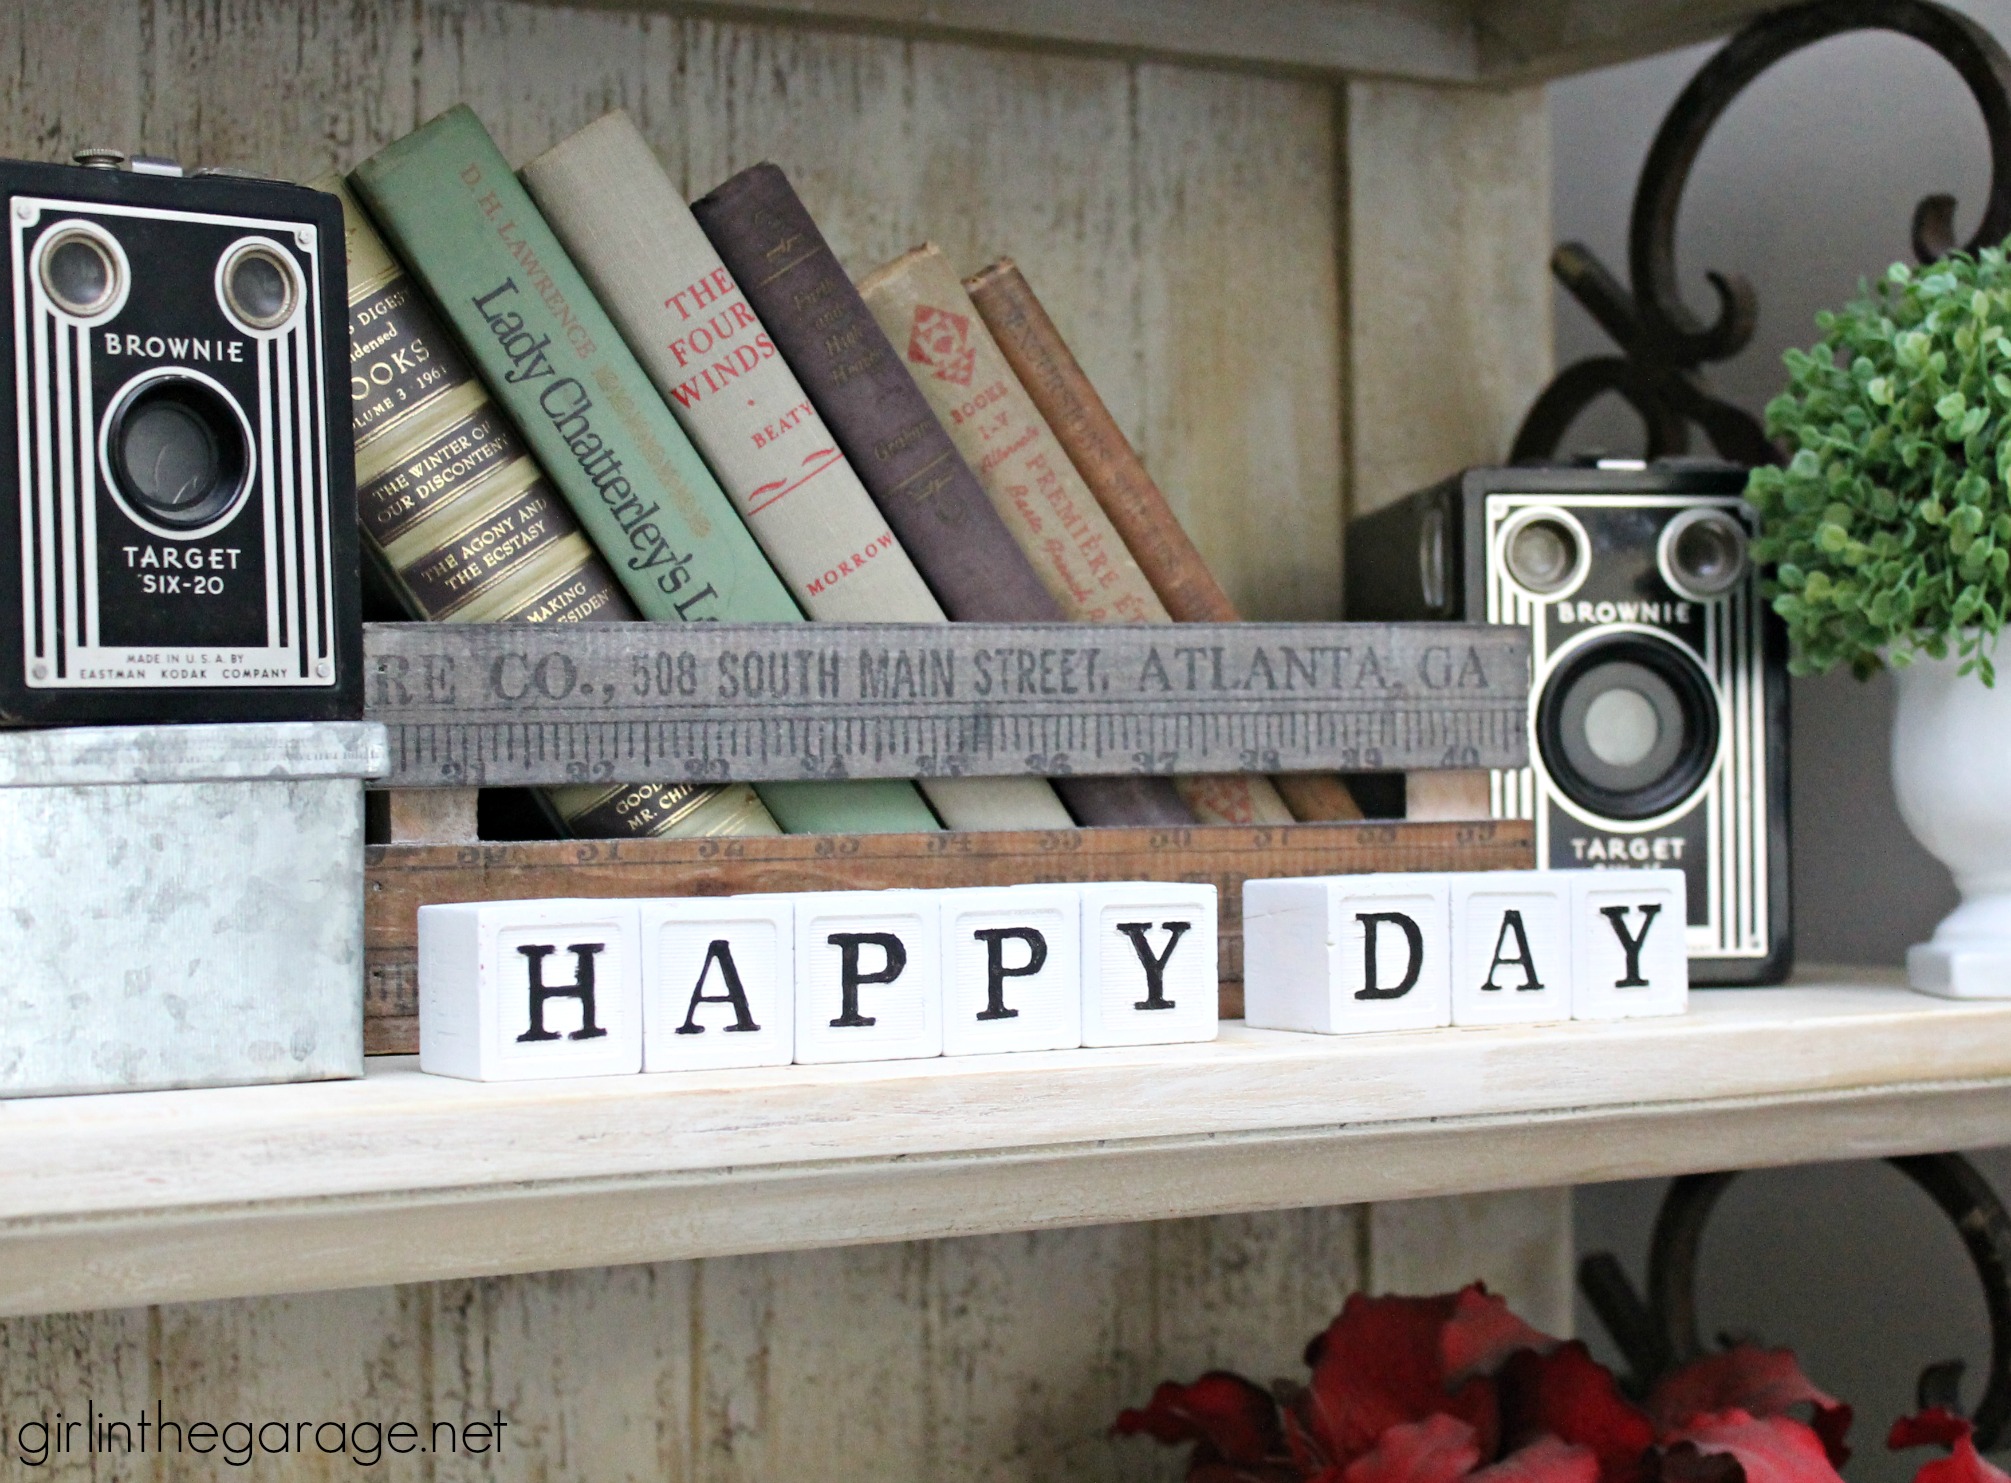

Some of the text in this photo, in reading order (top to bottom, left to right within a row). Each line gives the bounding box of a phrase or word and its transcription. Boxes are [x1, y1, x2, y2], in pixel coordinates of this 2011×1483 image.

[497, 219, 598, 360] LAWRENCE
[664, 266, 735, 321] THE
[104, 332, 244, 363] BROWNIE
[667, 302, 755, 368] FOUR
[351, 338, 430, 400] OOKS
[670, 331, 777, 410] WINDS
[352, 397, 395, 429] LUME
[396, 387, 407, 401] 3
[750, 400, 815, 450] BEATY
[472, 276, 556, 385] Lady
[539, 376, 693, 595] Chatterley's
[372, 473, 410, 502] THE
[408, 435, 473, 480] WINTER
[377, 494, 416, 523] OUR
[122, 545, 242, 570] TARGET
[421, 498, 548, 584] THE AGONY AND
[445, 520, 546, 591] THE ECSTASY
[806, 530, 894, 597] MORROW
[141, 574, 225, 595] SIX-20
[526, 582, 587, 624] MAKING
[1557, 600, 1692, 625] BROWNIE
[80, 669, 289, 680] EASTMAN KODAK COMPANY
[126, 653, 160, 664] MADE
[166, 653, 180, 664] IN
[231, 653, 244, 664] BY
[632, 650, 698, 698] 508
[717, 649, 840, 699] SOUTH
[859, 649, 955, 699] MAIN
[626, 807, 659, 832] MR.
[1570, 837, 1686, 861] TARGET
